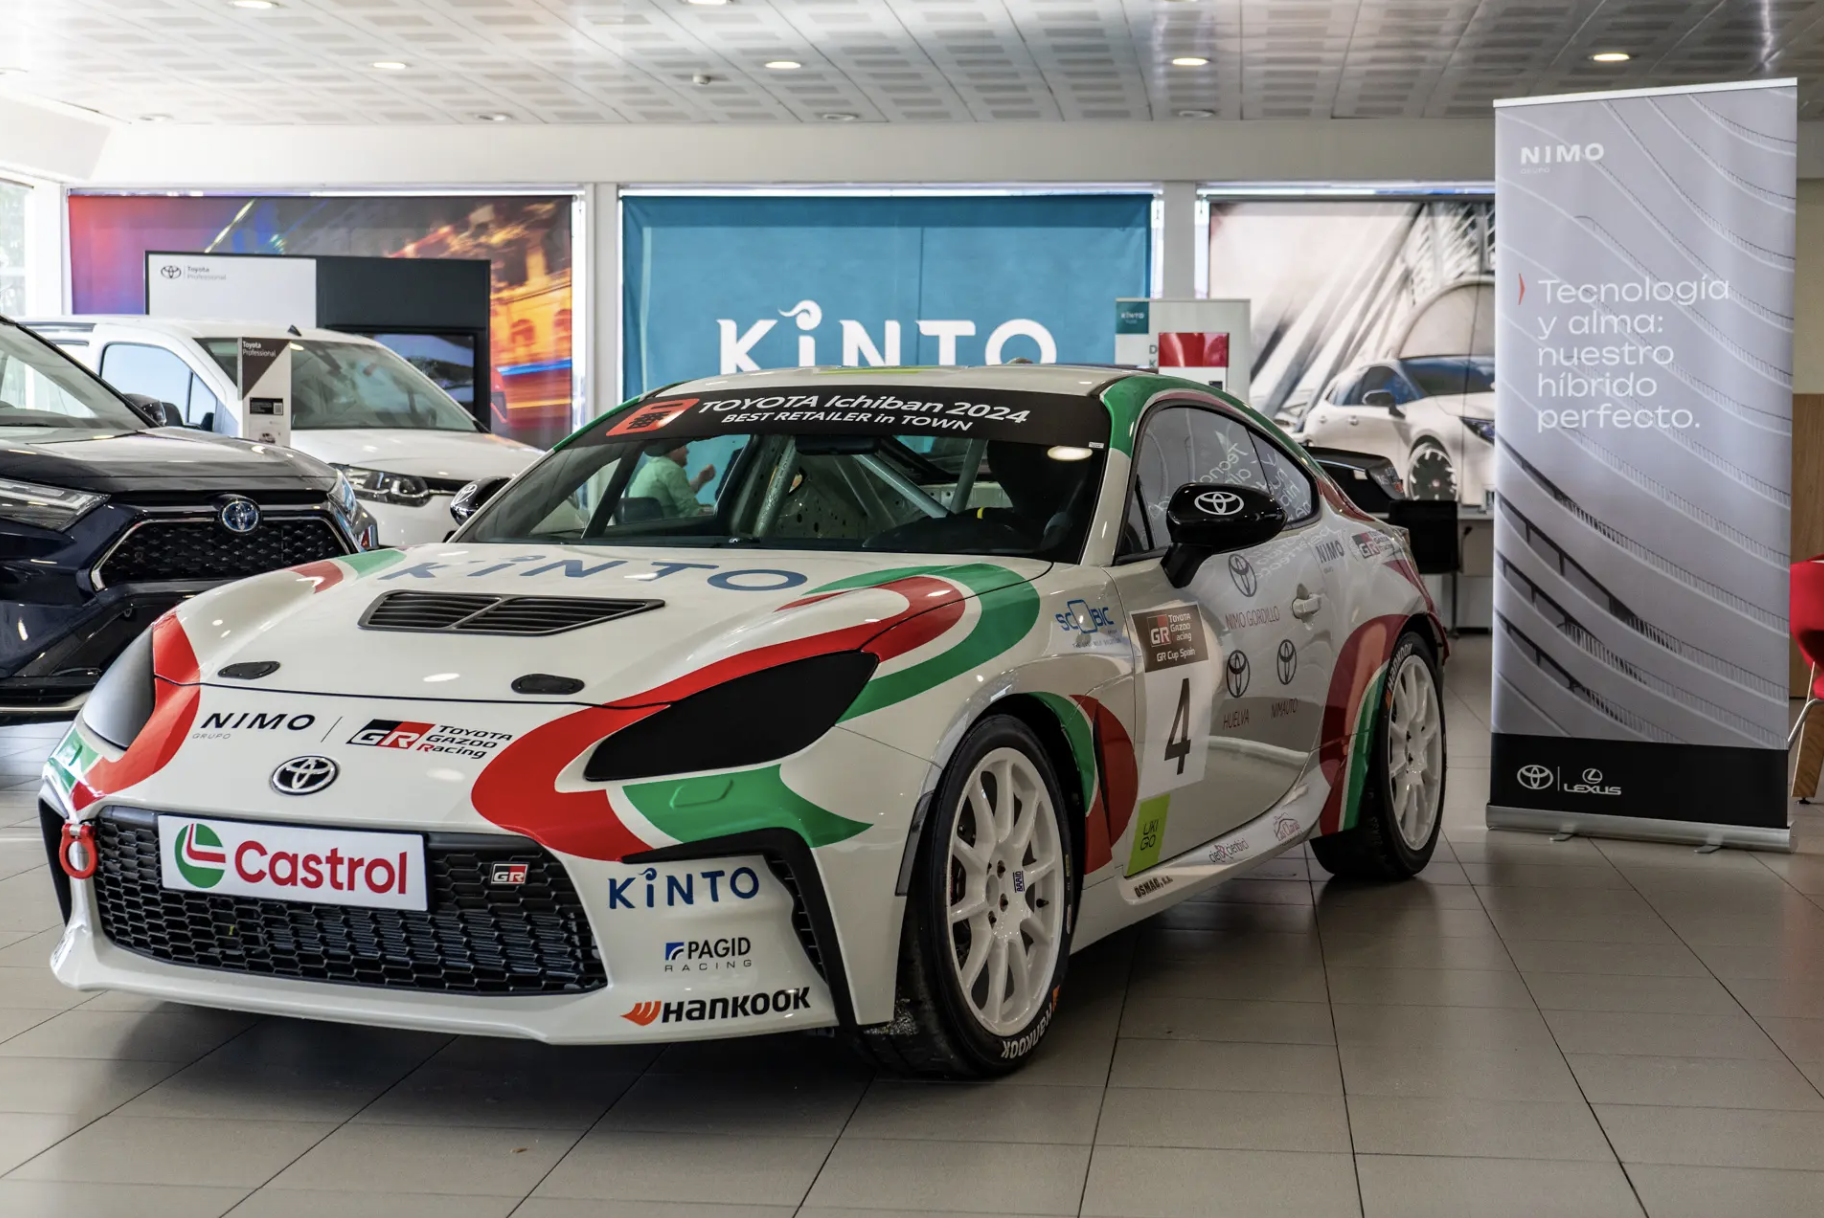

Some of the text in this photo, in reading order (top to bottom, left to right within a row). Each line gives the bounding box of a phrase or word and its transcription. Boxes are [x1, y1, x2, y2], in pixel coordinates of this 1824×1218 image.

[1520, 143, 1605, 164] NIMO
[1538, 274, 1730, 305] Tecnología
[1538, 310, 1664, 340] y alma:
[242, 341, 262, 349] Toyota
[1538, 342, 1674, 367] nuestro
[1538, 372, 1658, 398] híbrido
[699, 395, 1031, 424] TOYOTA Ichiban 2024
[1538, 403, 1701, 434] perfecto.
[721, 411, 974, 431] BEST RETAILER in TOWN
[1316, 540, 1345, 564] NIMO
[1168, 613, 1192, 623] TOYOTA
[1170, 623, 1191, 632] GAZOO
[1225, 606, 1280, 629] NIMO GORDILLO
[1157, 647, 1196, 662] GR Cup Spain
[200, 713, 316, 731] NIMO
[1164, 678, 1191, 776] 4
[1223, 709, 1250, 730] HUELVA
[425, 734, 499, 749] GAZOO
[438, 724, 514, 742] TOYOTA
[415, 743, 488, 760] Racing
[1563, 783, 1622, 796] LEXUS
[1140, 834, 1157, 851] GO
[234, 840, 408, 895] Castrol
[688, 937, 752, 960] PAGID
[664, 959, 752, 972] RACING
